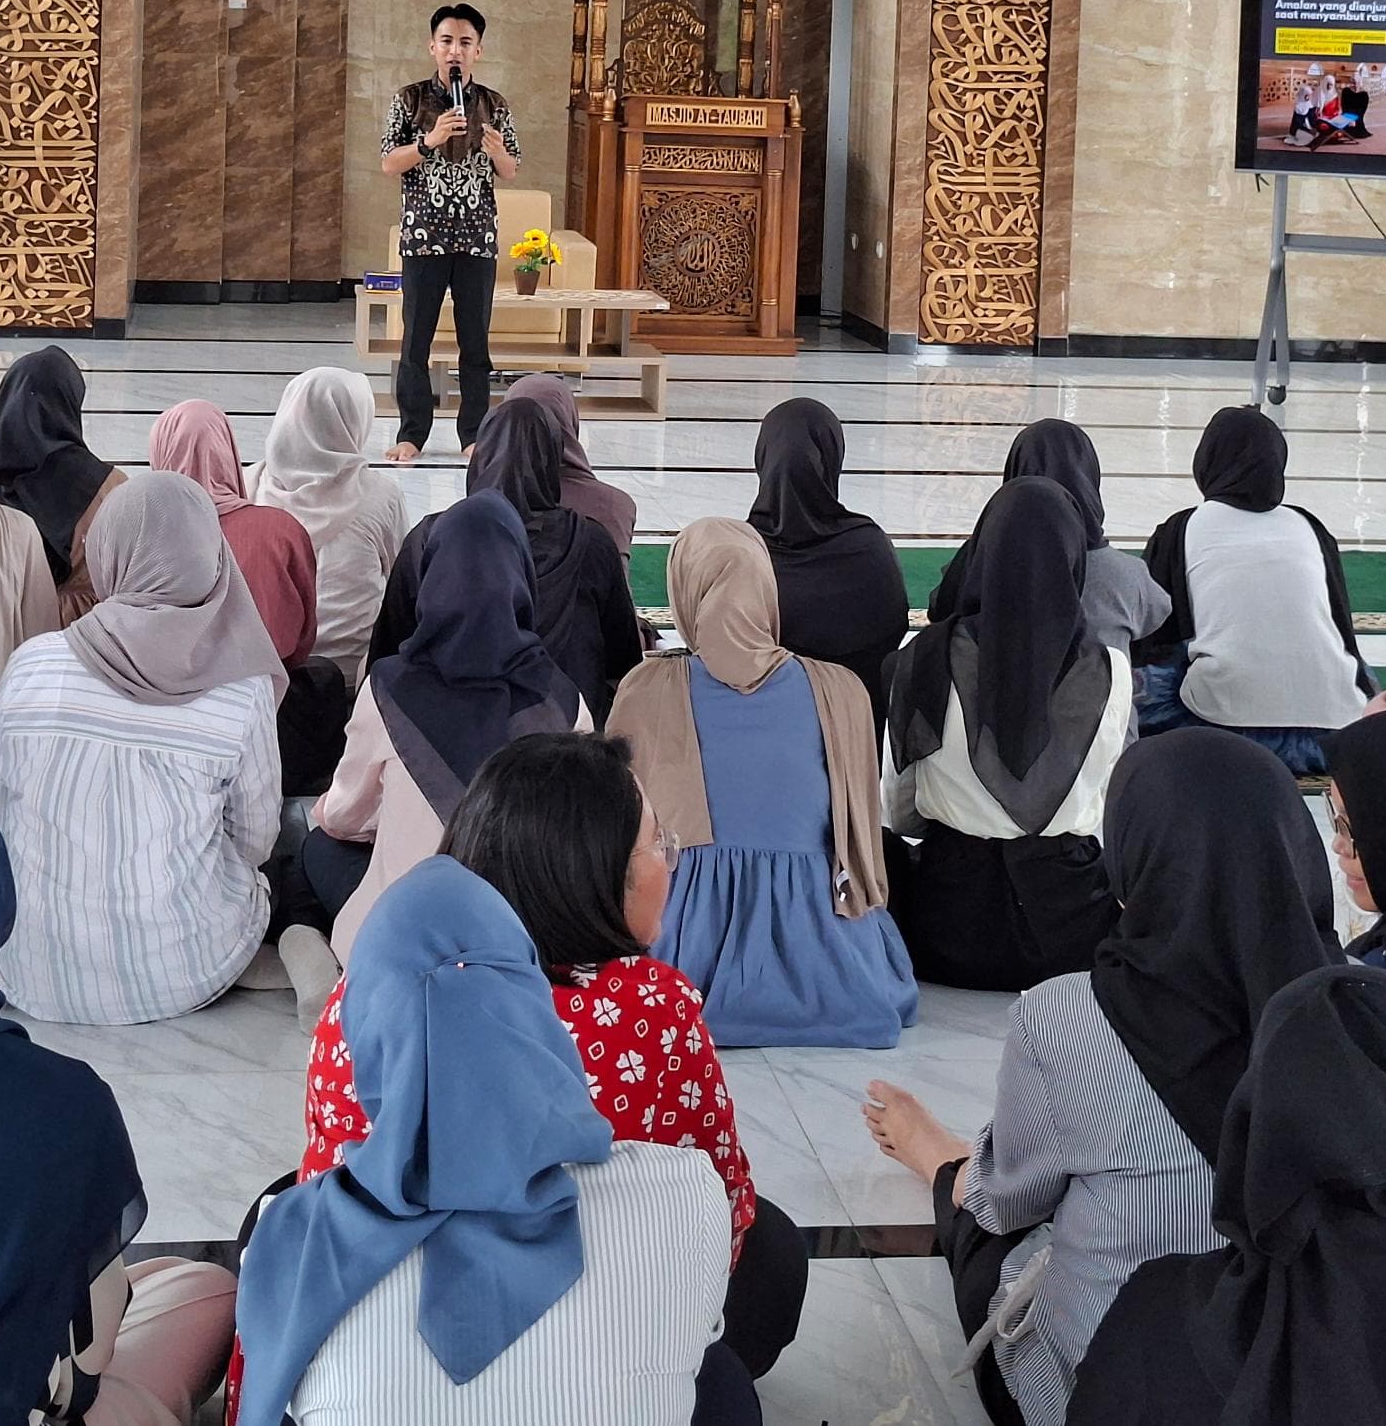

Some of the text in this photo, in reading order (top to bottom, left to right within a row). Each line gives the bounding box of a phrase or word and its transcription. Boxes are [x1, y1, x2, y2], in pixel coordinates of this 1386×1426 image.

[1274, 0, 1317, 10] Amalan
[1319, 1, 1348, 14] yang
[1274, 10, 1299, 20] saat
[1300, 11, 1366, 23] menyambut
[651, 106, 764, 126] MASJID AT-TAUBAH
